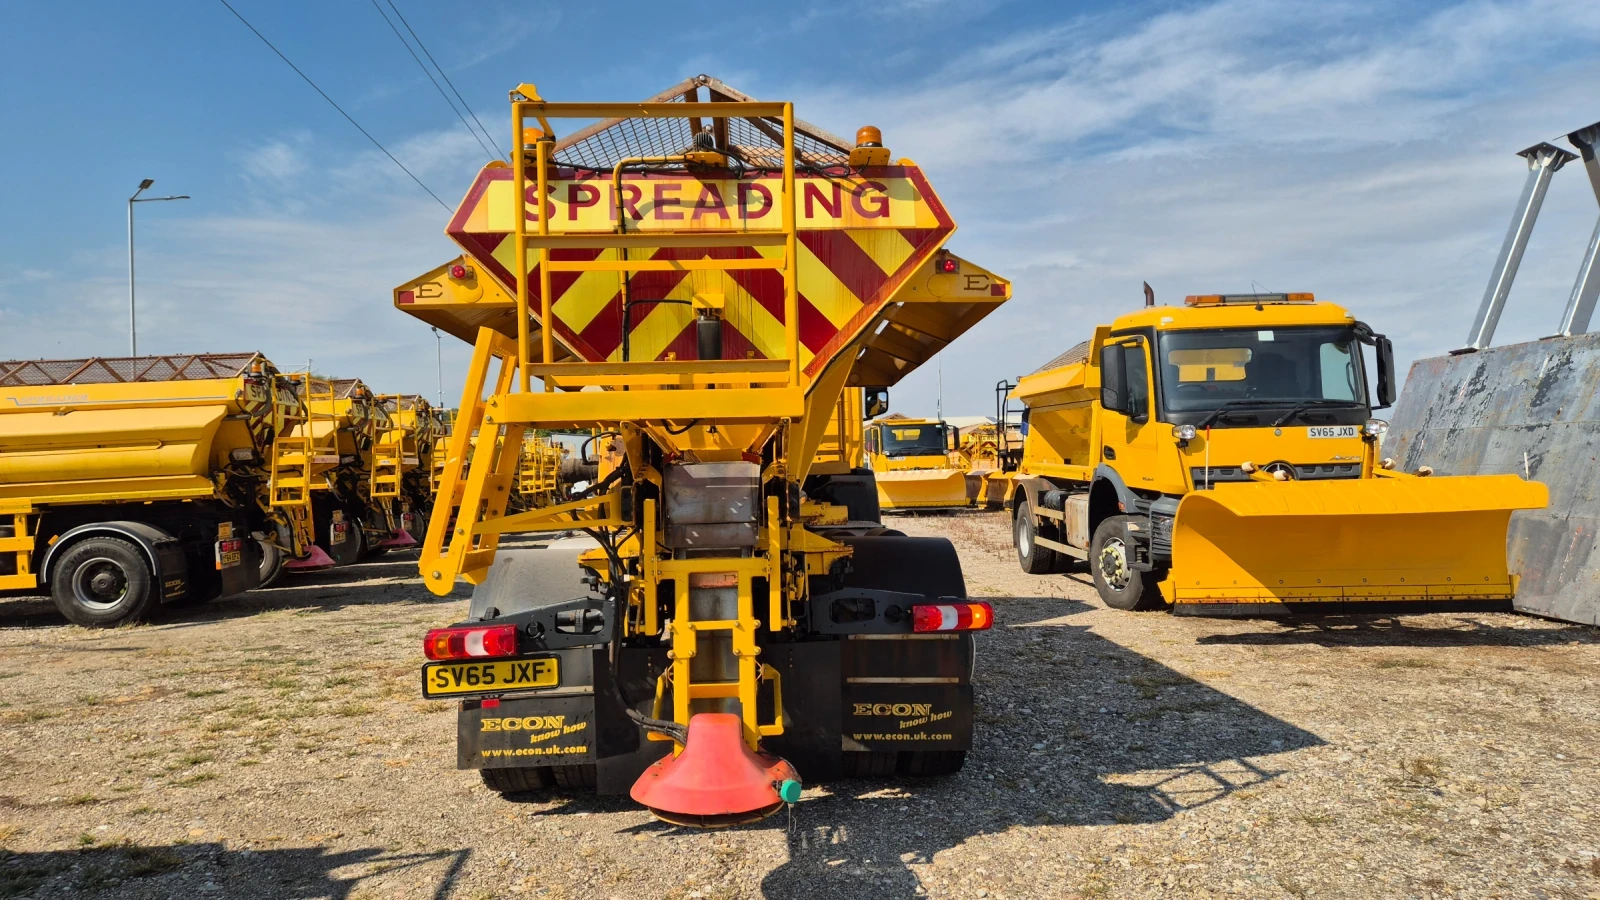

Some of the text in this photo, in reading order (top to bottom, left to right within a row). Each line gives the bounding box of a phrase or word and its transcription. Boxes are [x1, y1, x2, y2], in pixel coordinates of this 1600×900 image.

[525, 180, 890, 222] SPREADNG
[1310, 427, 1354, 437] SV65 JXD
[435, 662, 546, 688] SV65 JXF
[853, 703, 932, 716] ECON
[480, 715, 565, 732] ECON
[899, 710, 953, 729] know how
[530, 721, 587, 744] know how
[853, 731, 952, 740] www.econ.uk.com
[481, 744, 587, 757] www.econ.uk.com
